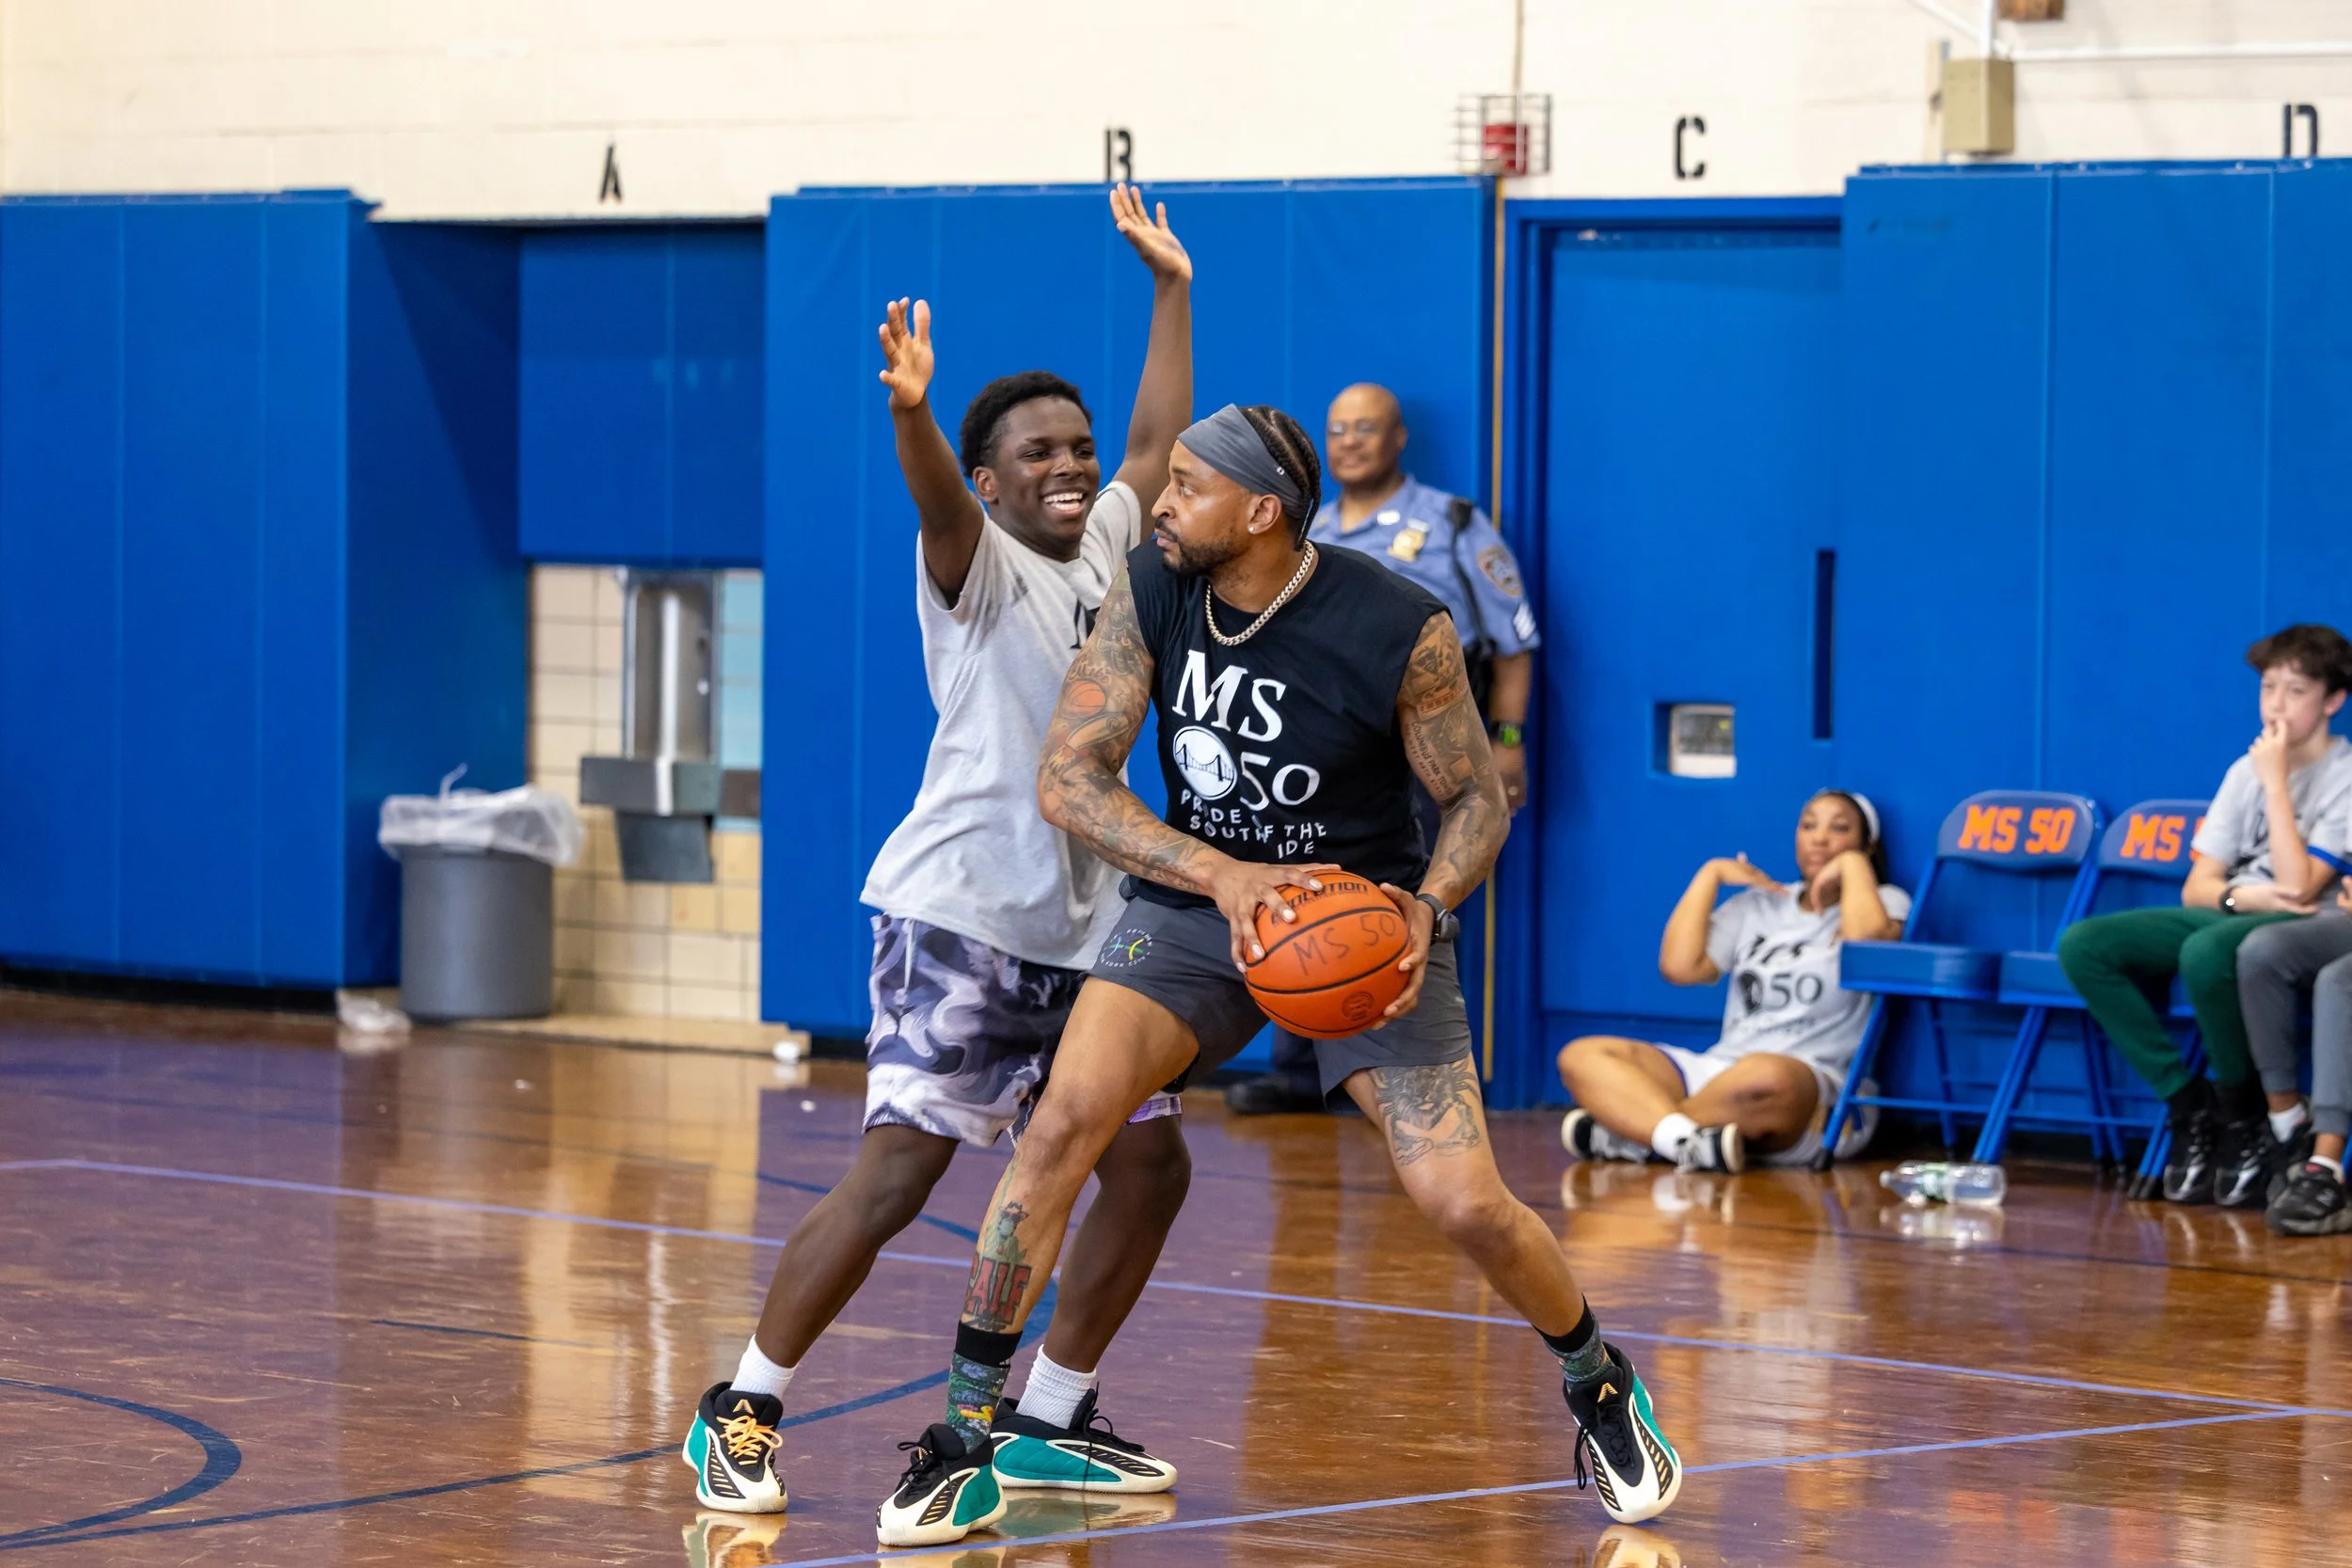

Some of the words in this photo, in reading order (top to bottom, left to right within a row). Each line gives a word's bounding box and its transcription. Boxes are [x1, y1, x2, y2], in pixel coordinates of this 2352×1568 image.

[598, 143, 624, 203] A
[1673, 115, 1706, 180] C
[1172, 649, 1287, 742] MS
[1181, 788, 1242, 824] PRIDE
[1239, 752, 1321, 812] 50
[1283, 821, 1327, 840] THE
[1957, 804, 2022, 853] MS
[2025, 808, 2075, 854] 50
[2120, 813, 2186, 862] MS
[1293, 927, 1350, 976] MS
[1360, 913, 1396, 946] 50
[1762, 972, 1824, 1013] 50
